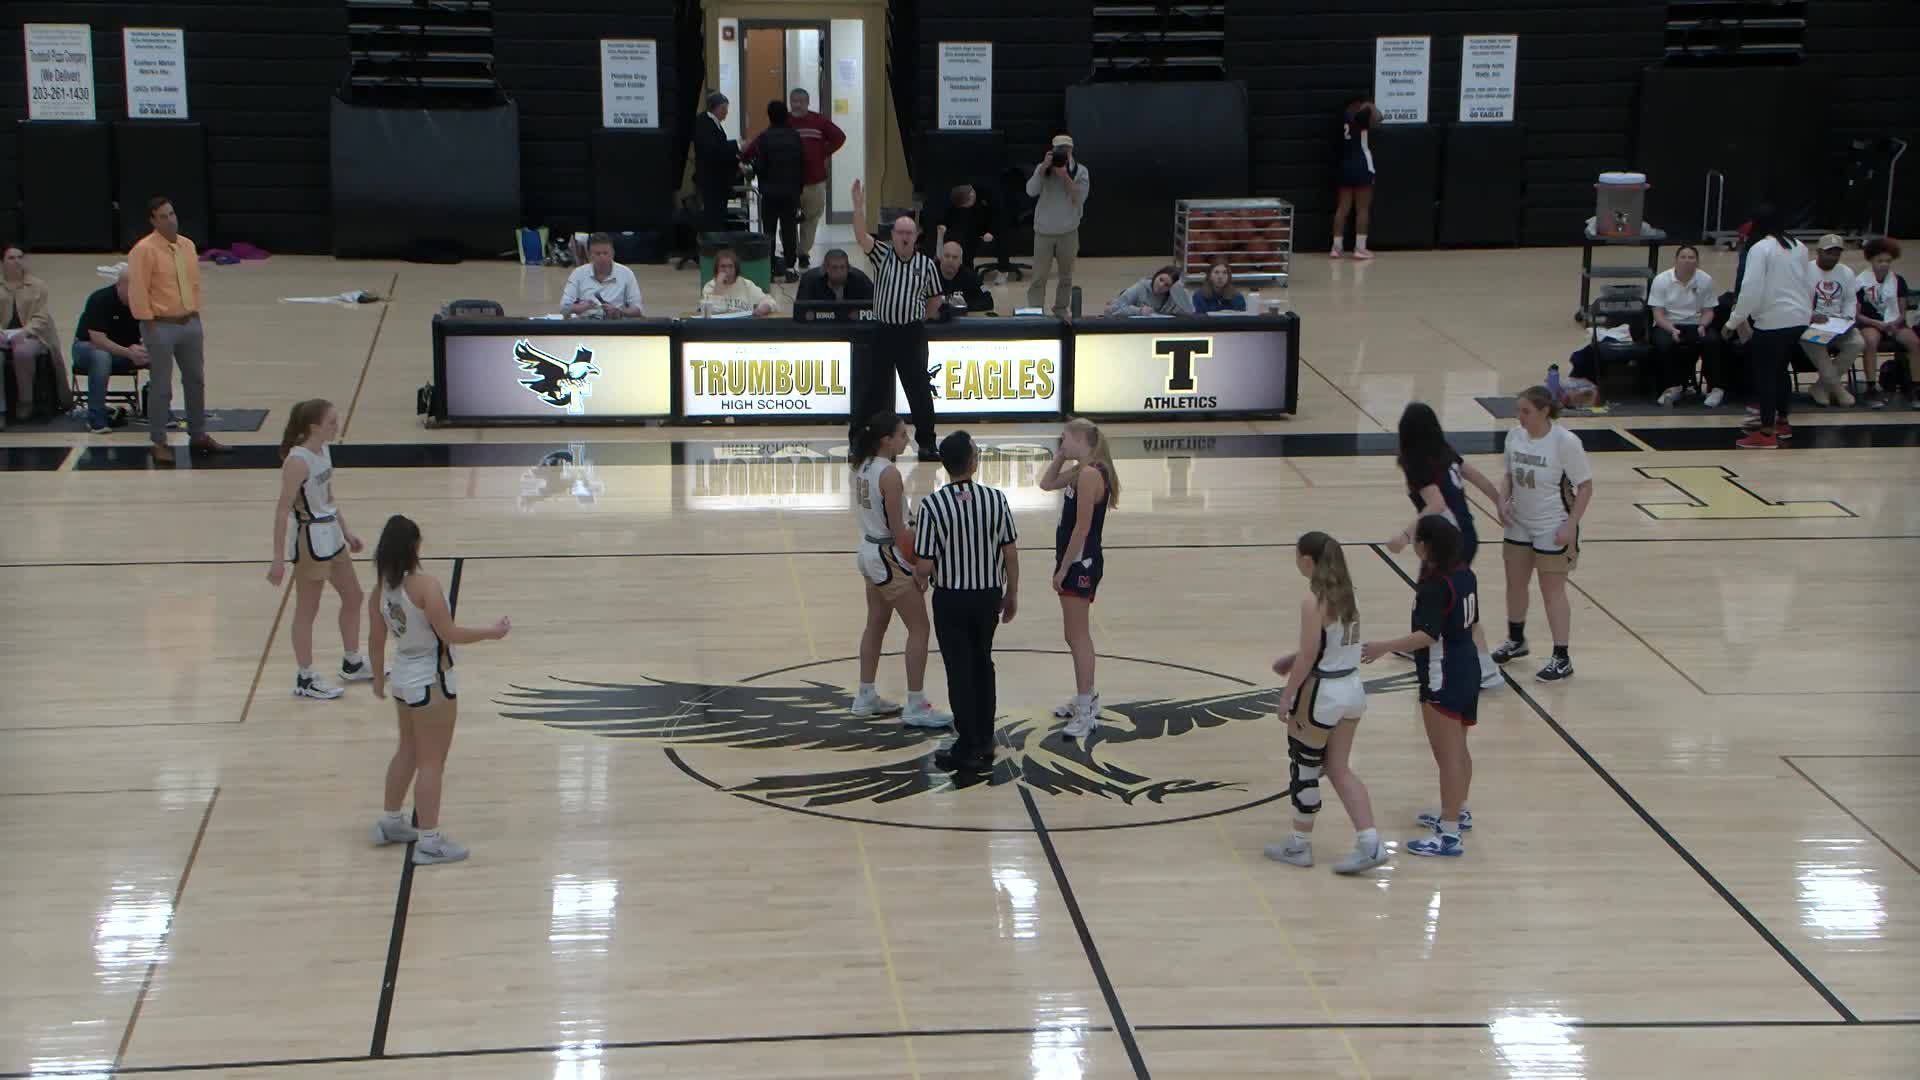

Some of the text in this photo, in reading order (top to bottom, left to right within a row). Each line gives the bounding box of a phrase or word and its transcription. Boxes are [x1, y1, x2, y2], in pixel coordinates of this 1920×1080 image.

[32, 86, 89, 100] 203-261-1430
[1153, 337, 1213, 392] T
[689, 359, 847, 396] TRUMBULL
[945, 358, 1055, 400] EAGLES
[721, 399, 813, 410] HIGH SCHOOL
[1143, 396, 1217, 409] ATHLETICS
